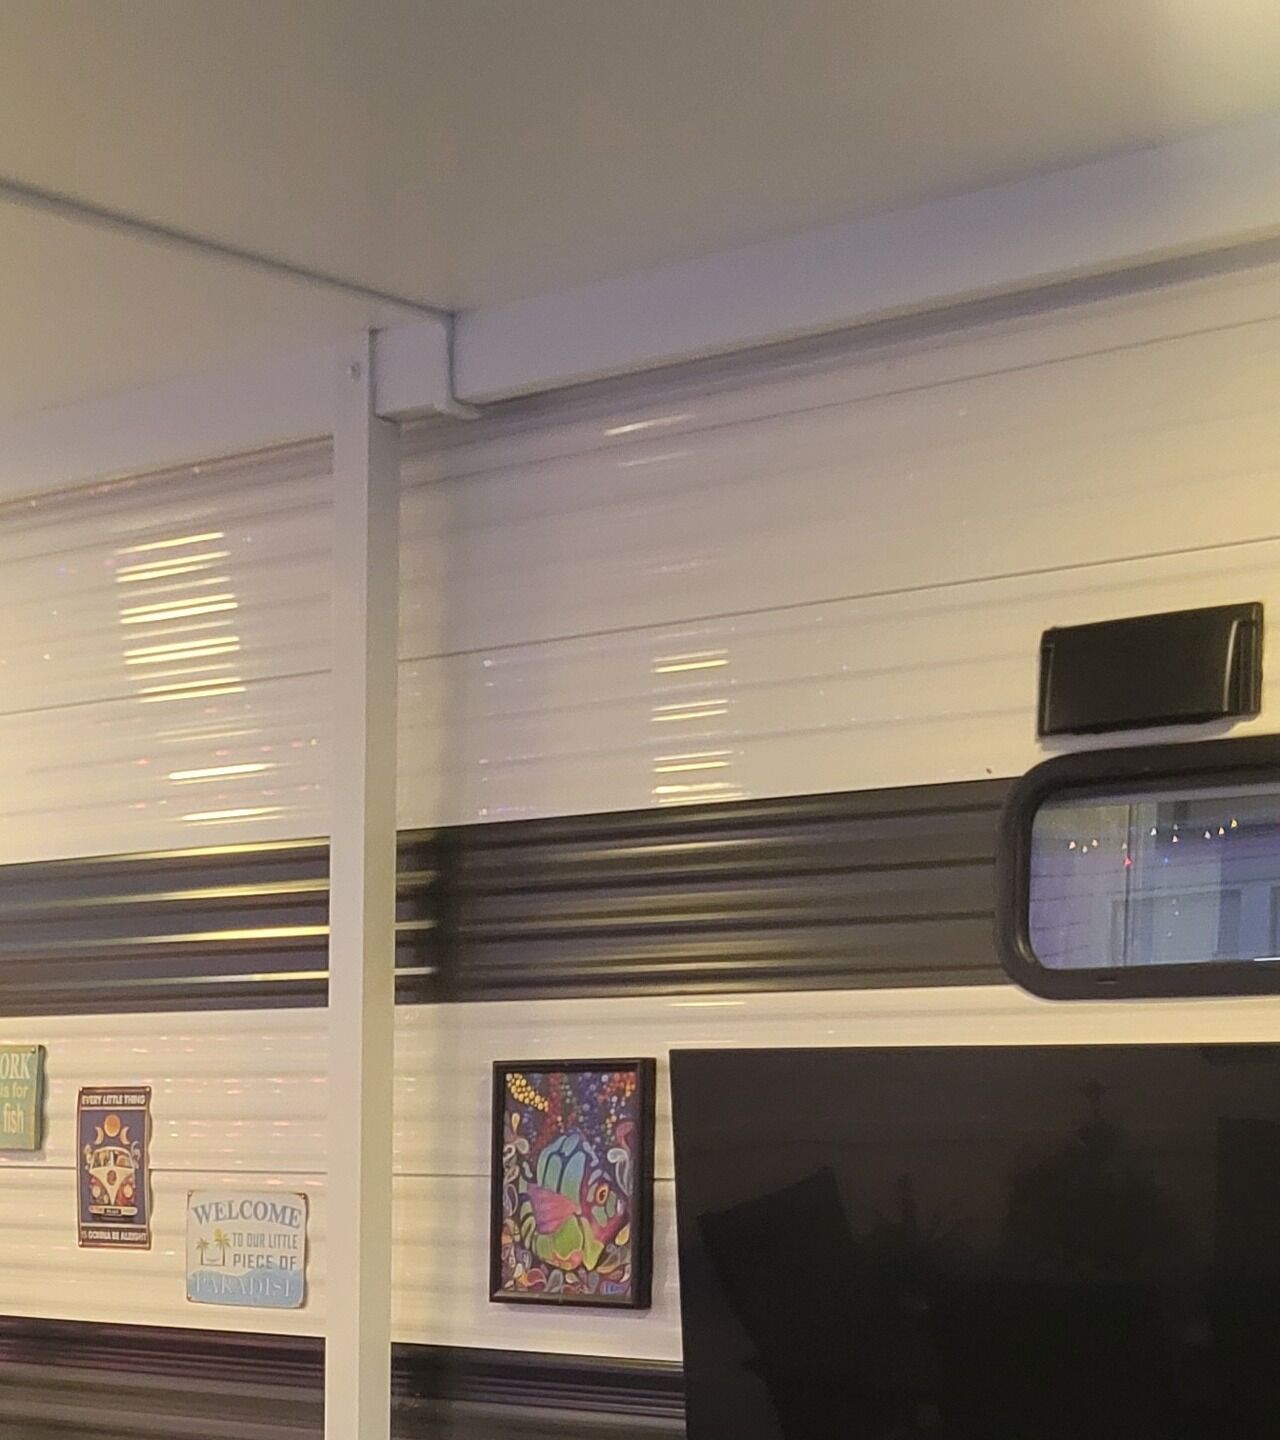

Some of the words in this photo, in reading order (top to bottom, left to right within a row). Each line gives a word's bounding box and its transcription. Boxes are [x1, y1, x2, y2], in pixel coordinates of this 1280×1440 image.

[0, 1083, 9, 1098] is
[11, 1081, 28, 1098] for
[103, 1094, 123, 1105] LITTLE
[124, 1095, 145, 1105] THING
[3, 1102, 24, 1133] fish
[192, 1200, 302, 1229] WELCOME
[232, 1232, 243, 1247] TO
[246, 1233, 265, 1248] OUR
[268, 1234, 298, 1249] LITTLE
[233, 1253, 273, 1270] PIECE
[280, 1255, 297, 1271] OF
[194, 1274, 294, 1298] PARADISE
